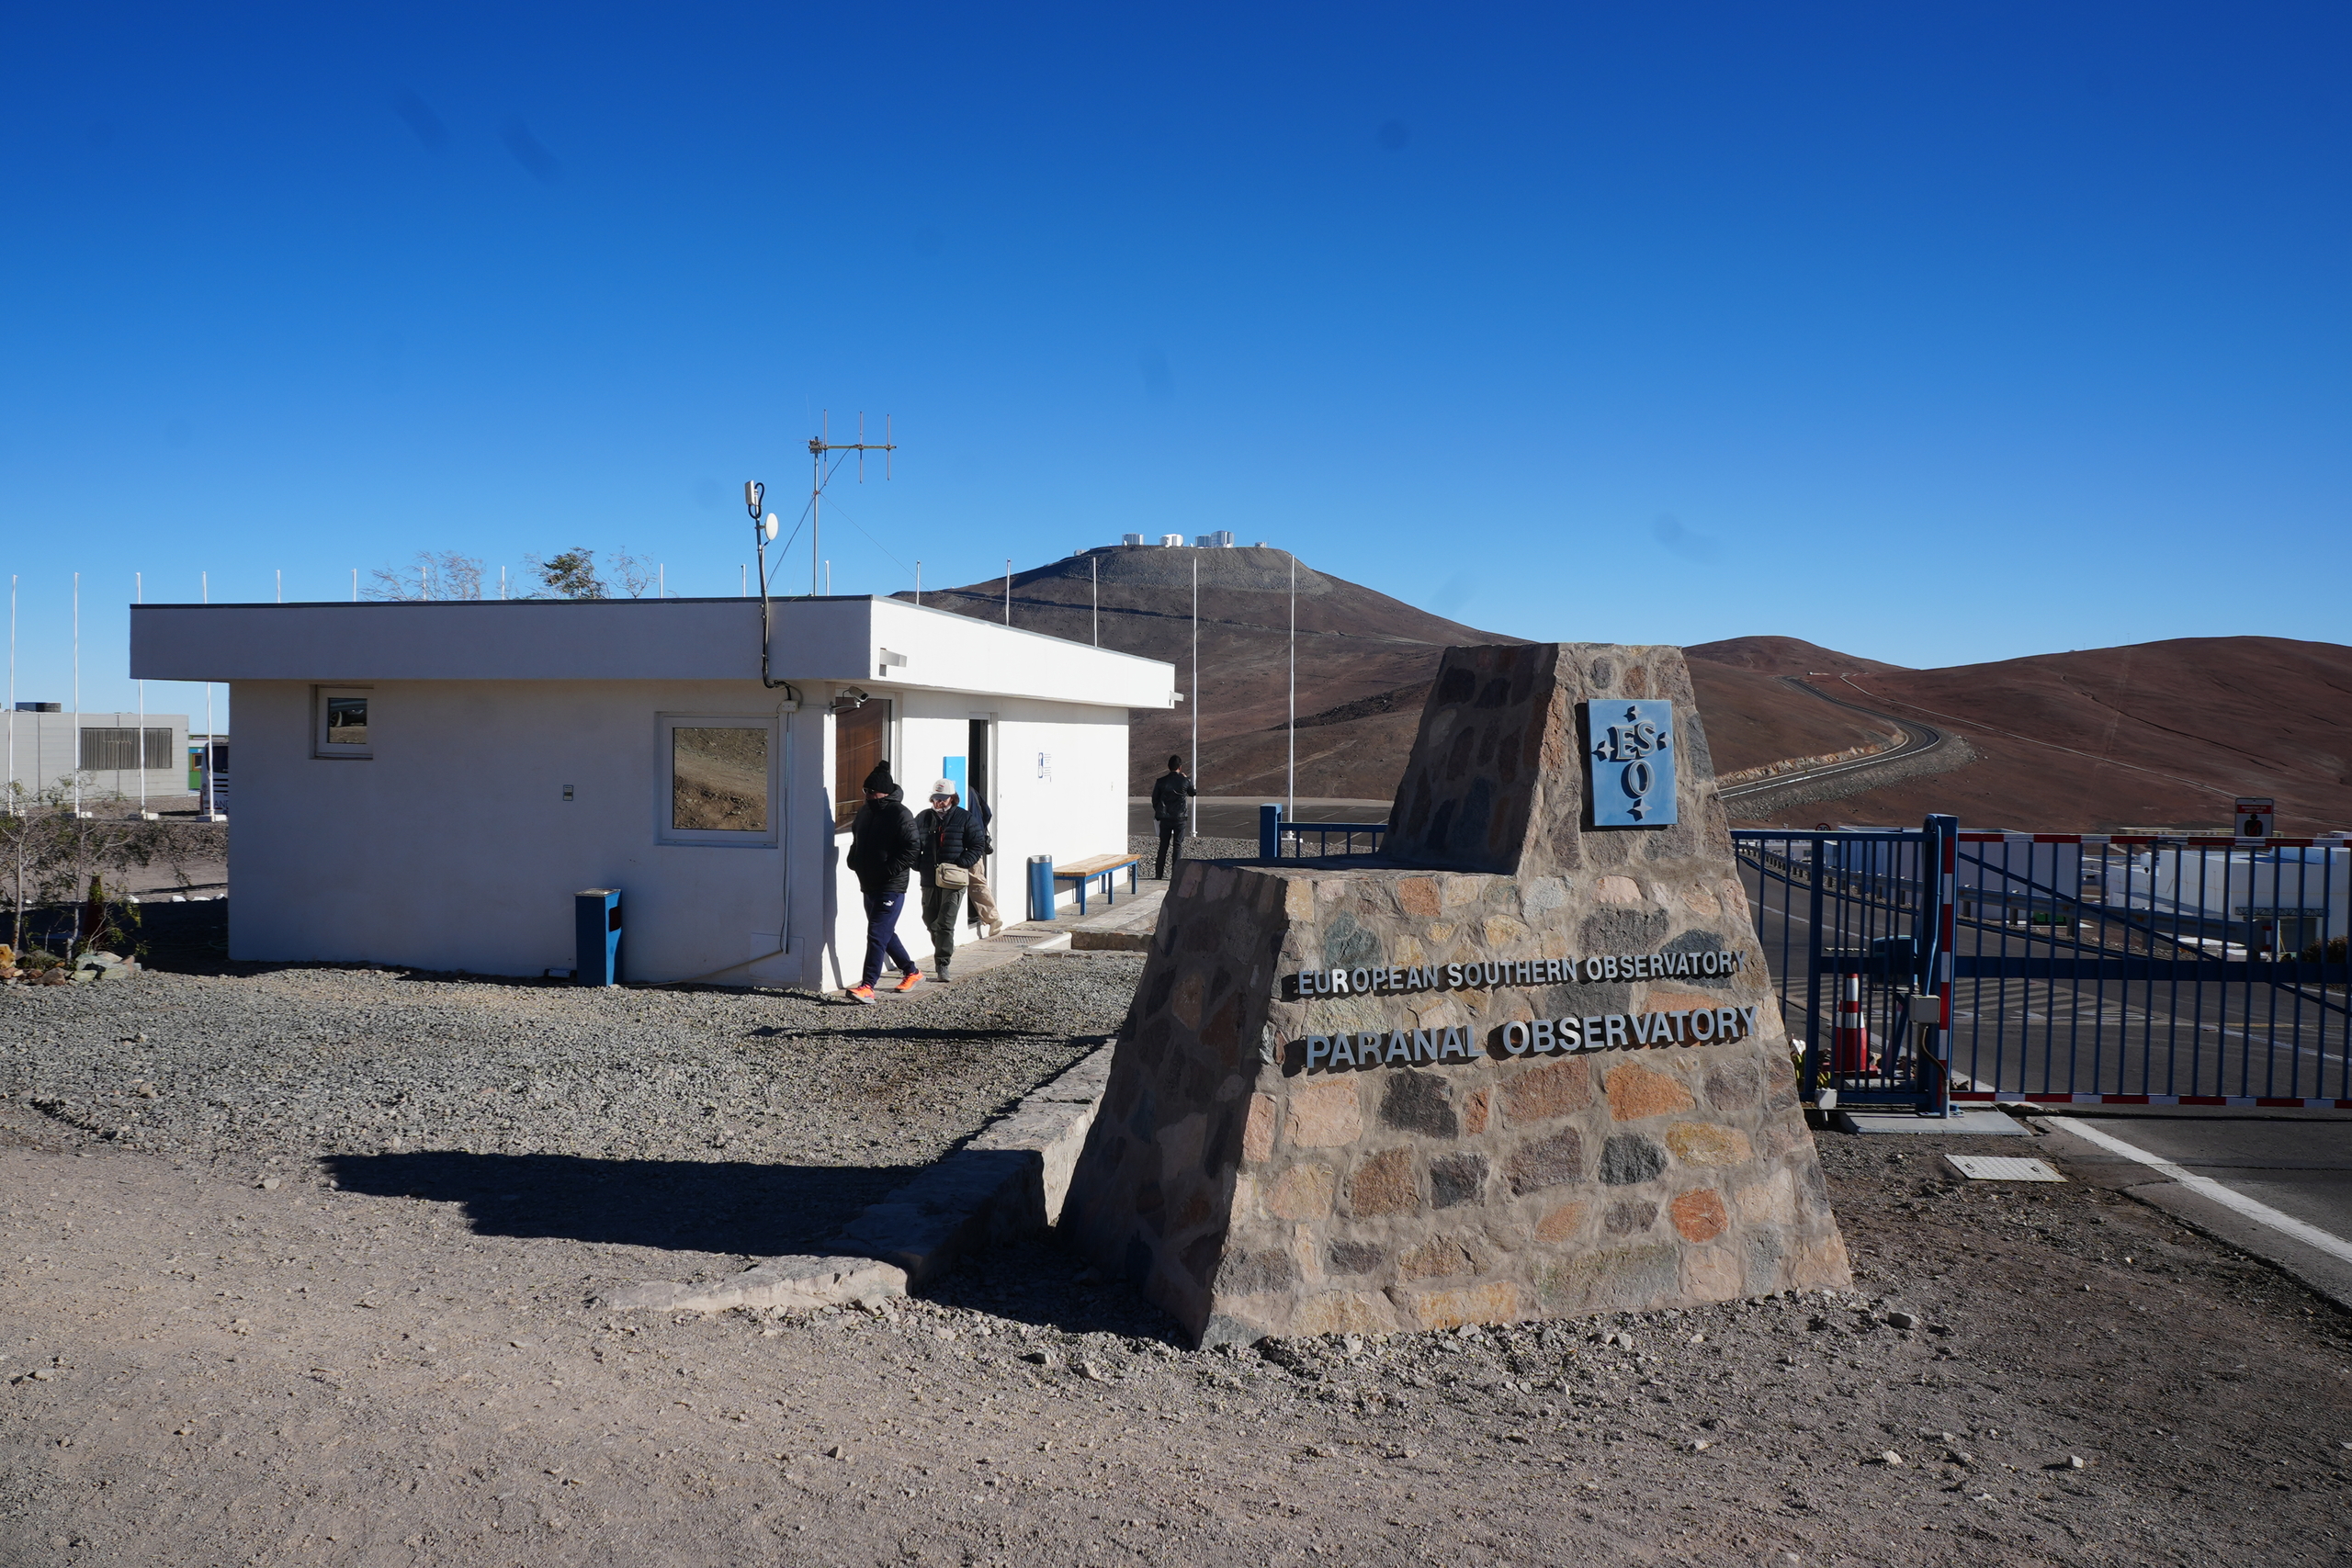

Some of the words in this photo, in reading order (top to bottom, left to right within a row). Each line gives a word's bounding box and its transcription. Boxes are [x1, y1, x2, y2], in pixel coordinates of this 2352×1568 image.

[1298, 965, 1439, 995] EUROPEAN
[1447, 957, 1577, 987] SOUTHERN
[1586, 951, 1747, 980] OBSERVATORY
[1306, 1024, 1487, 1069] PARANAL
[1502, 1005, 1758, 1055] OBSERVATORY
